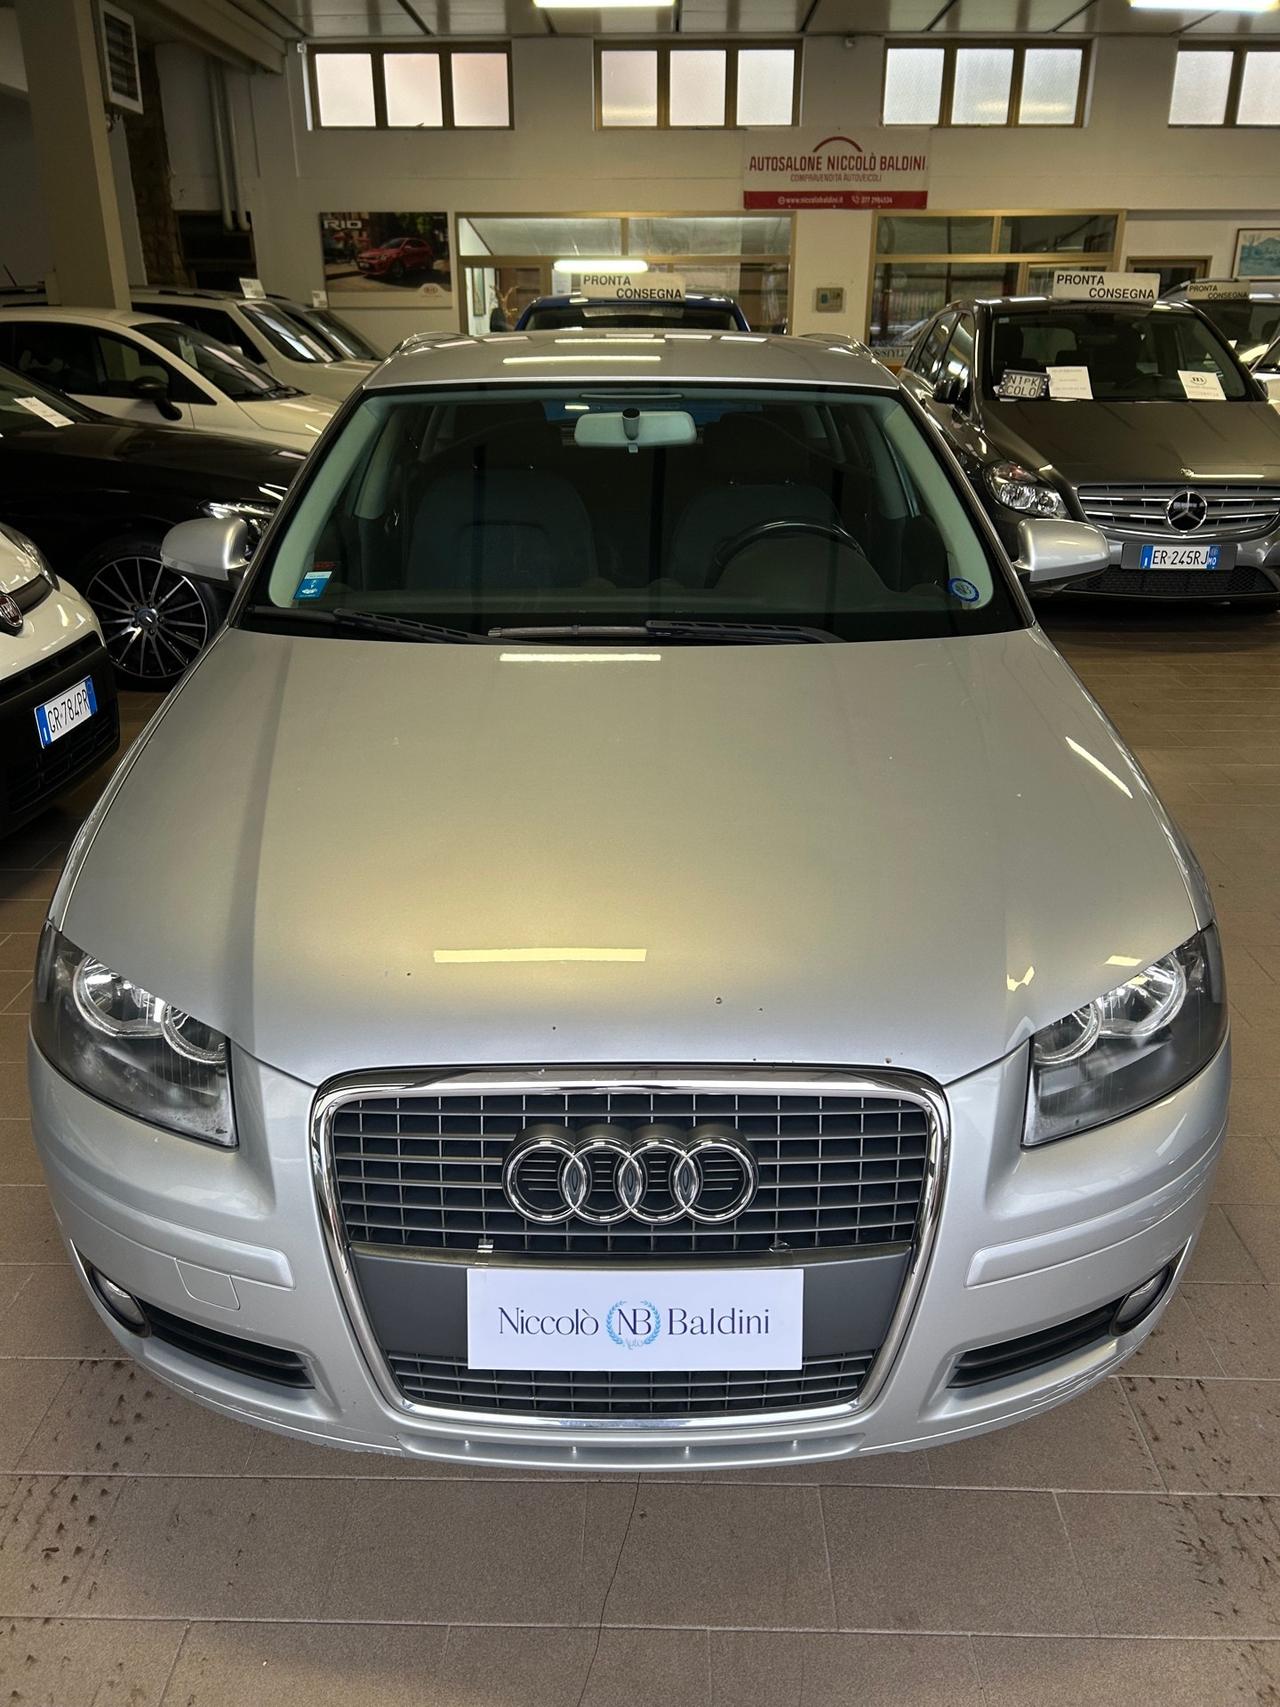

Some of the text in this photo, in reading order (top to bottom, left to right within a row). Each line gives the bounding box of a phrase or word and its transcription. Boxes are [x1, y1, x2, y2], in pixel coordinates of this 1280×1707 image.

[749, 152, 926, 171] AUTOSALONE NICCOLÒ BALDINI
[844, 173, 882, 183] AUTOVEICOLI
[324, 220, 362, 230] RIO
[583, 275, 631, 286] PRONTA
[1056, 275, 1105, 286] PRONTA
[616, 288, 682, 299] CONSEGNA
[1089, 287, 1155, 300] CONSEGNA
[1207, 292, 1249, 300] CONSEGNA
[498, 1307, 599, 1336] Niccolò
[668, 1306, 770, 1336] Baldini
